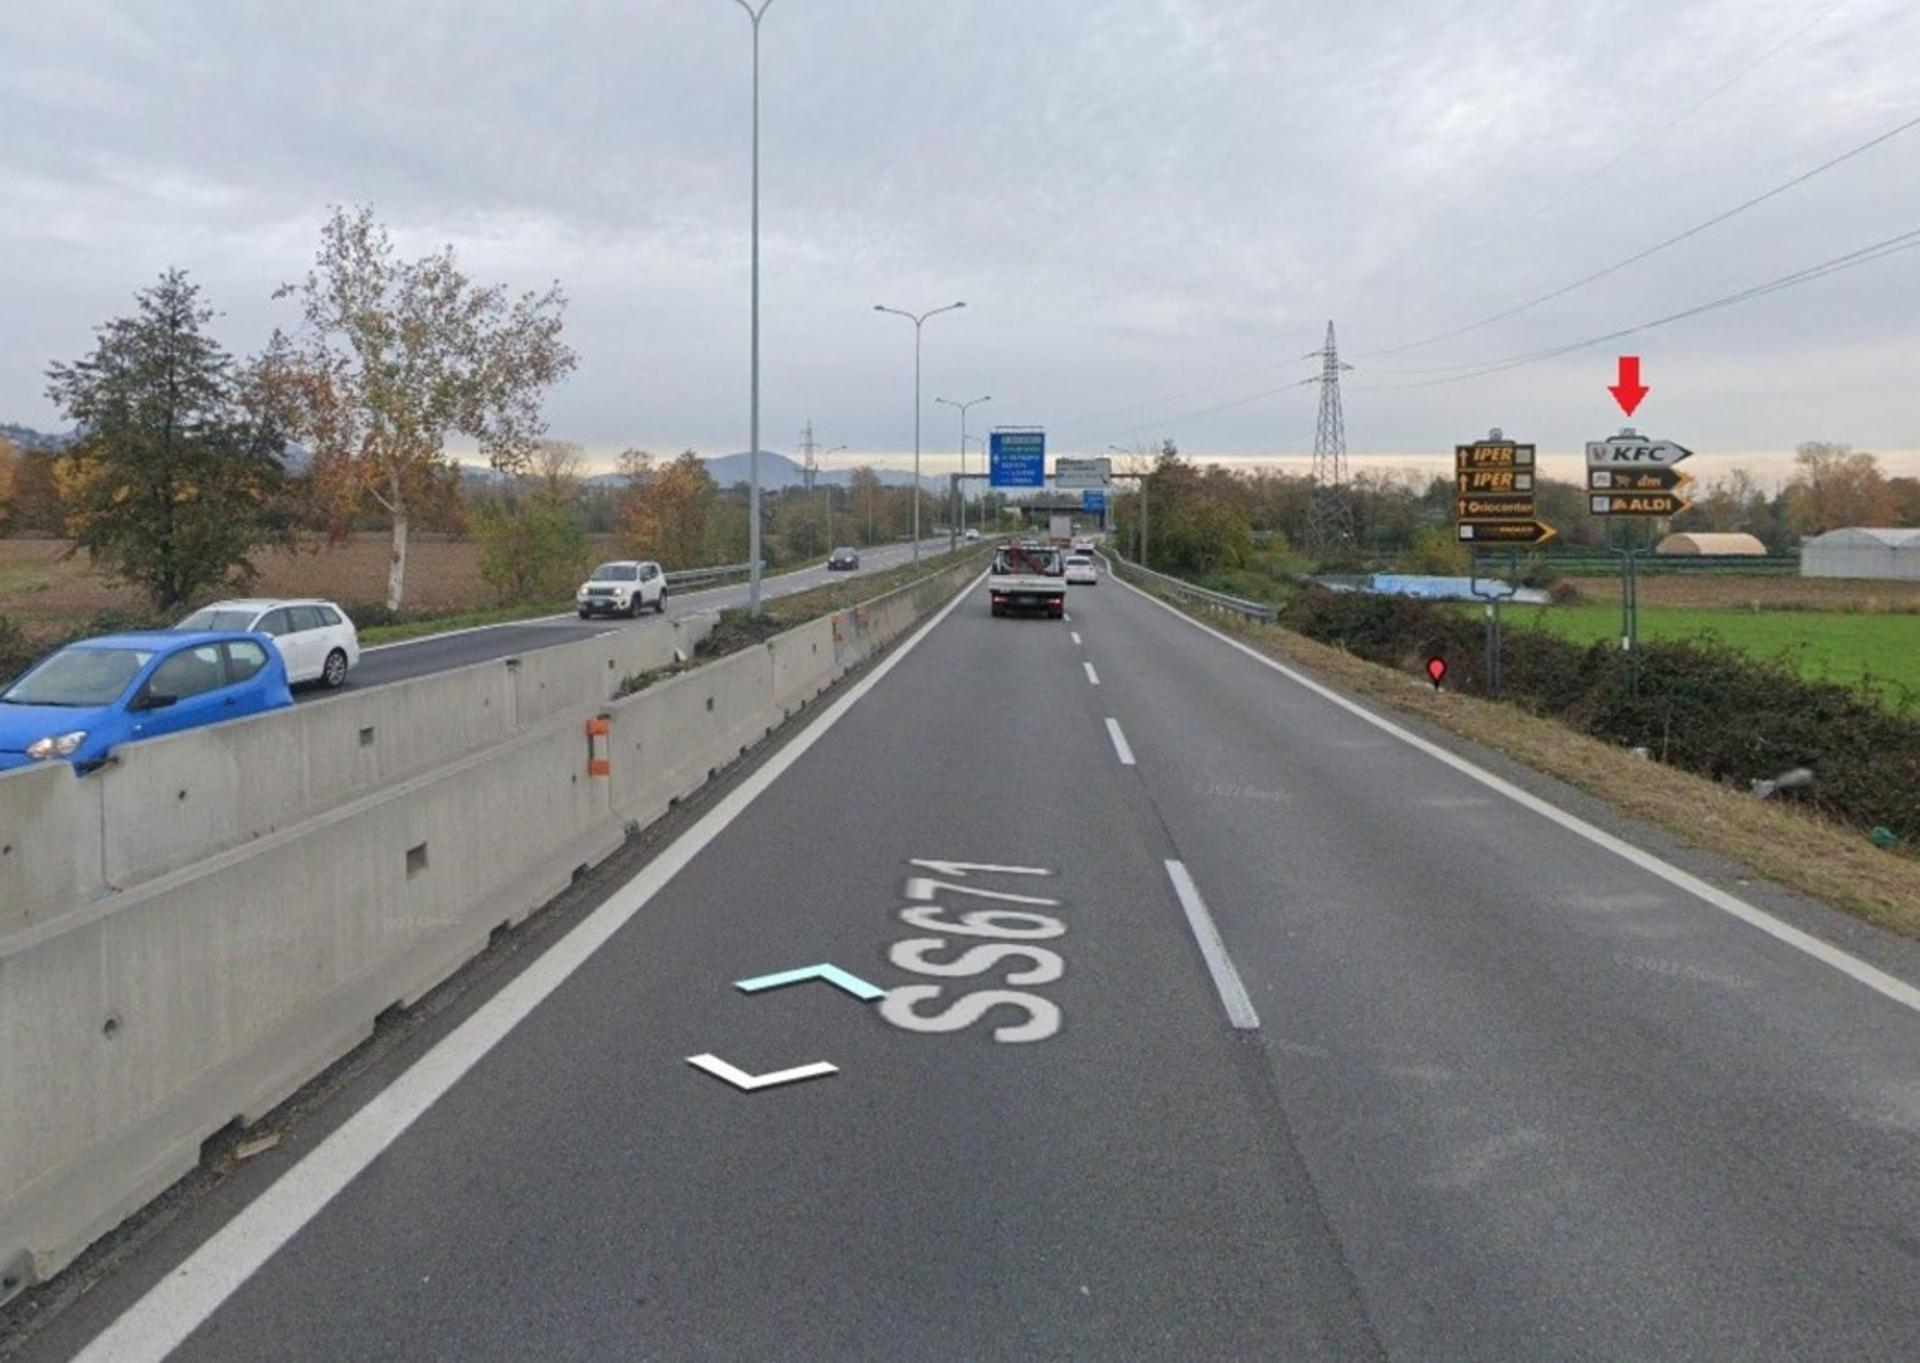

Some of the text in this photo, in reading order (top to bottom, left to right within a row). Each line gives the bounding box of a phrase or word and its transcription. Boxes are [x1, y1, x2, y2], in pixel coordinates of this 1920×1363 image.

[1473, 447, 1513, 461] IPER
[1612, 446, 1665, 462] KFC
[1473, 472, 1513, 486] IPER
[1630, 499, 1671, 511] ALDI
